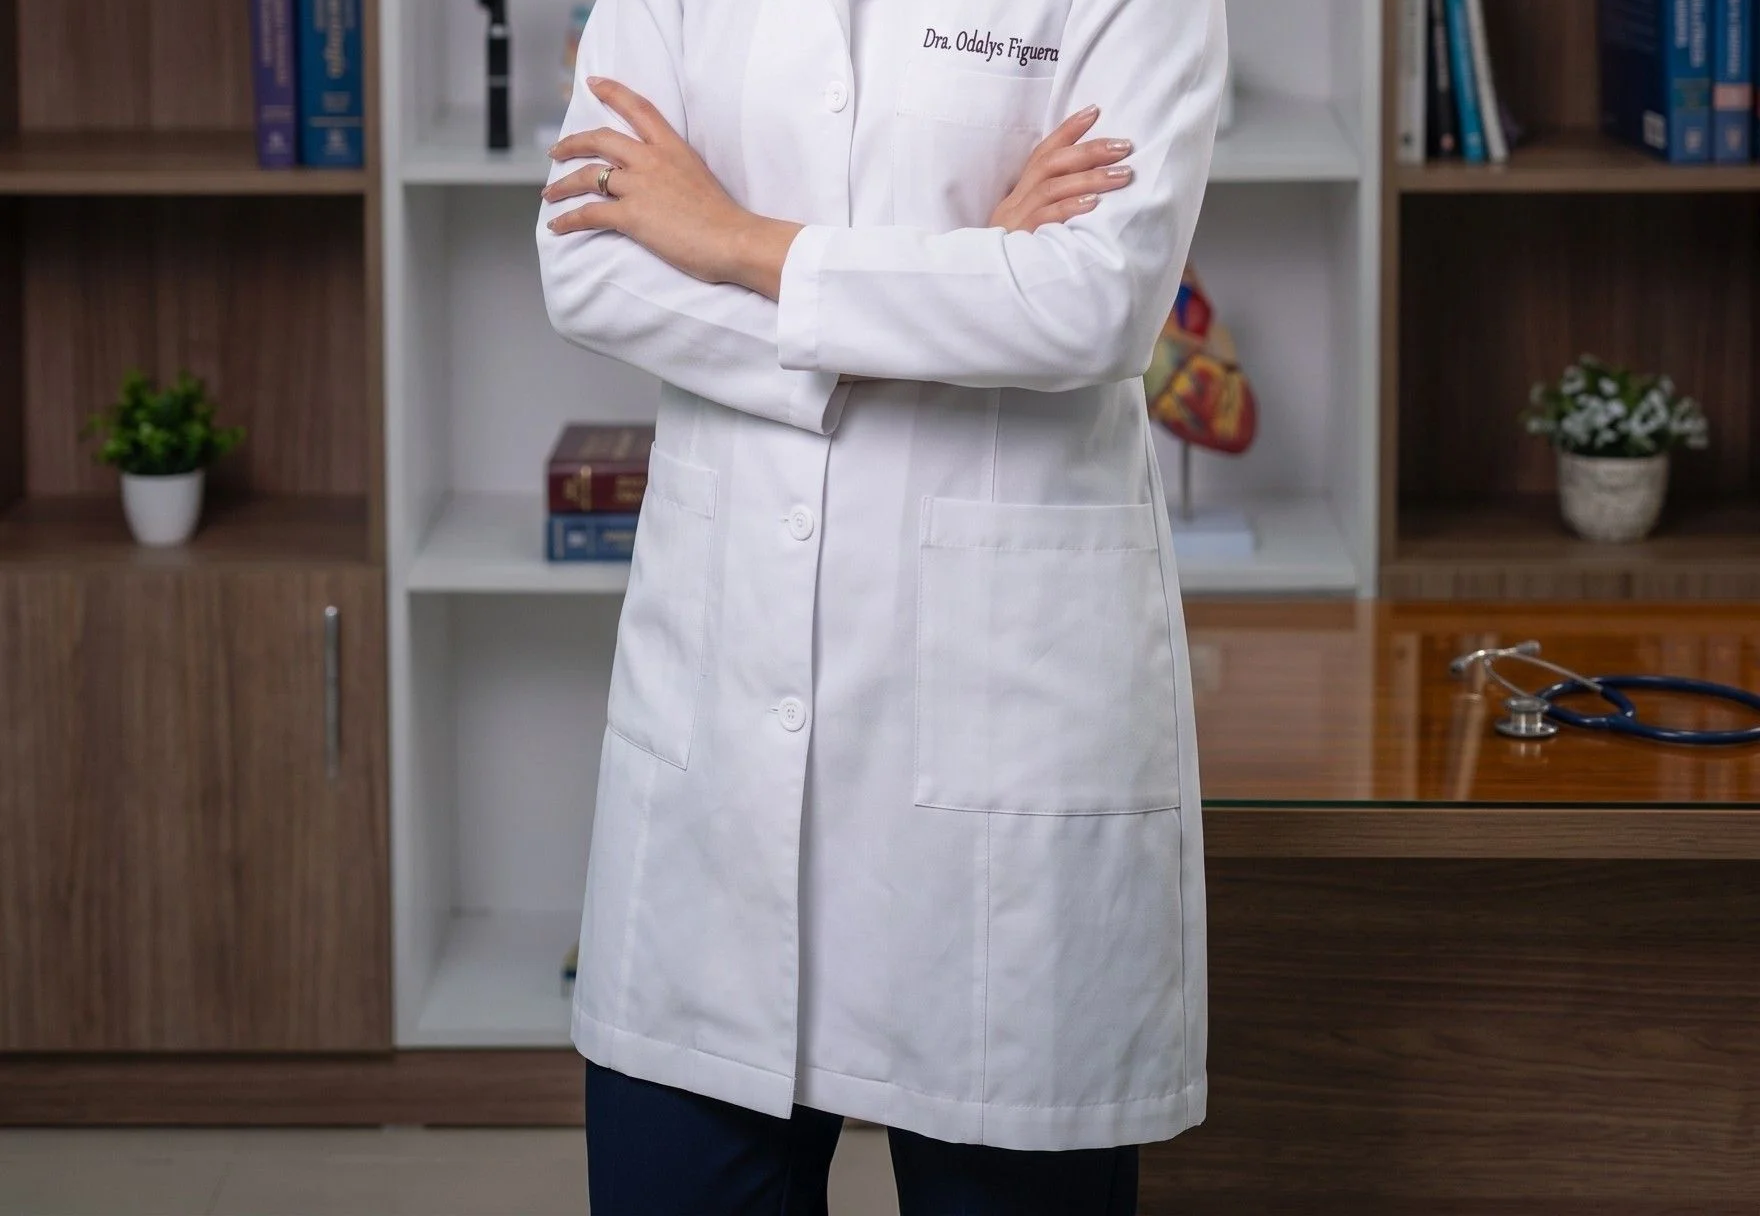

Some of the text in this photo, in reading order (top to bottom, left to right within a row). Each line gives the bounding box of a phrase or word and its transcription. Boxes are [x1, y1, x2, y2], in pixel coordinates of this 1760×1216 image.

[923, 28, 1060, 66] Dra. Odalys Figuera
